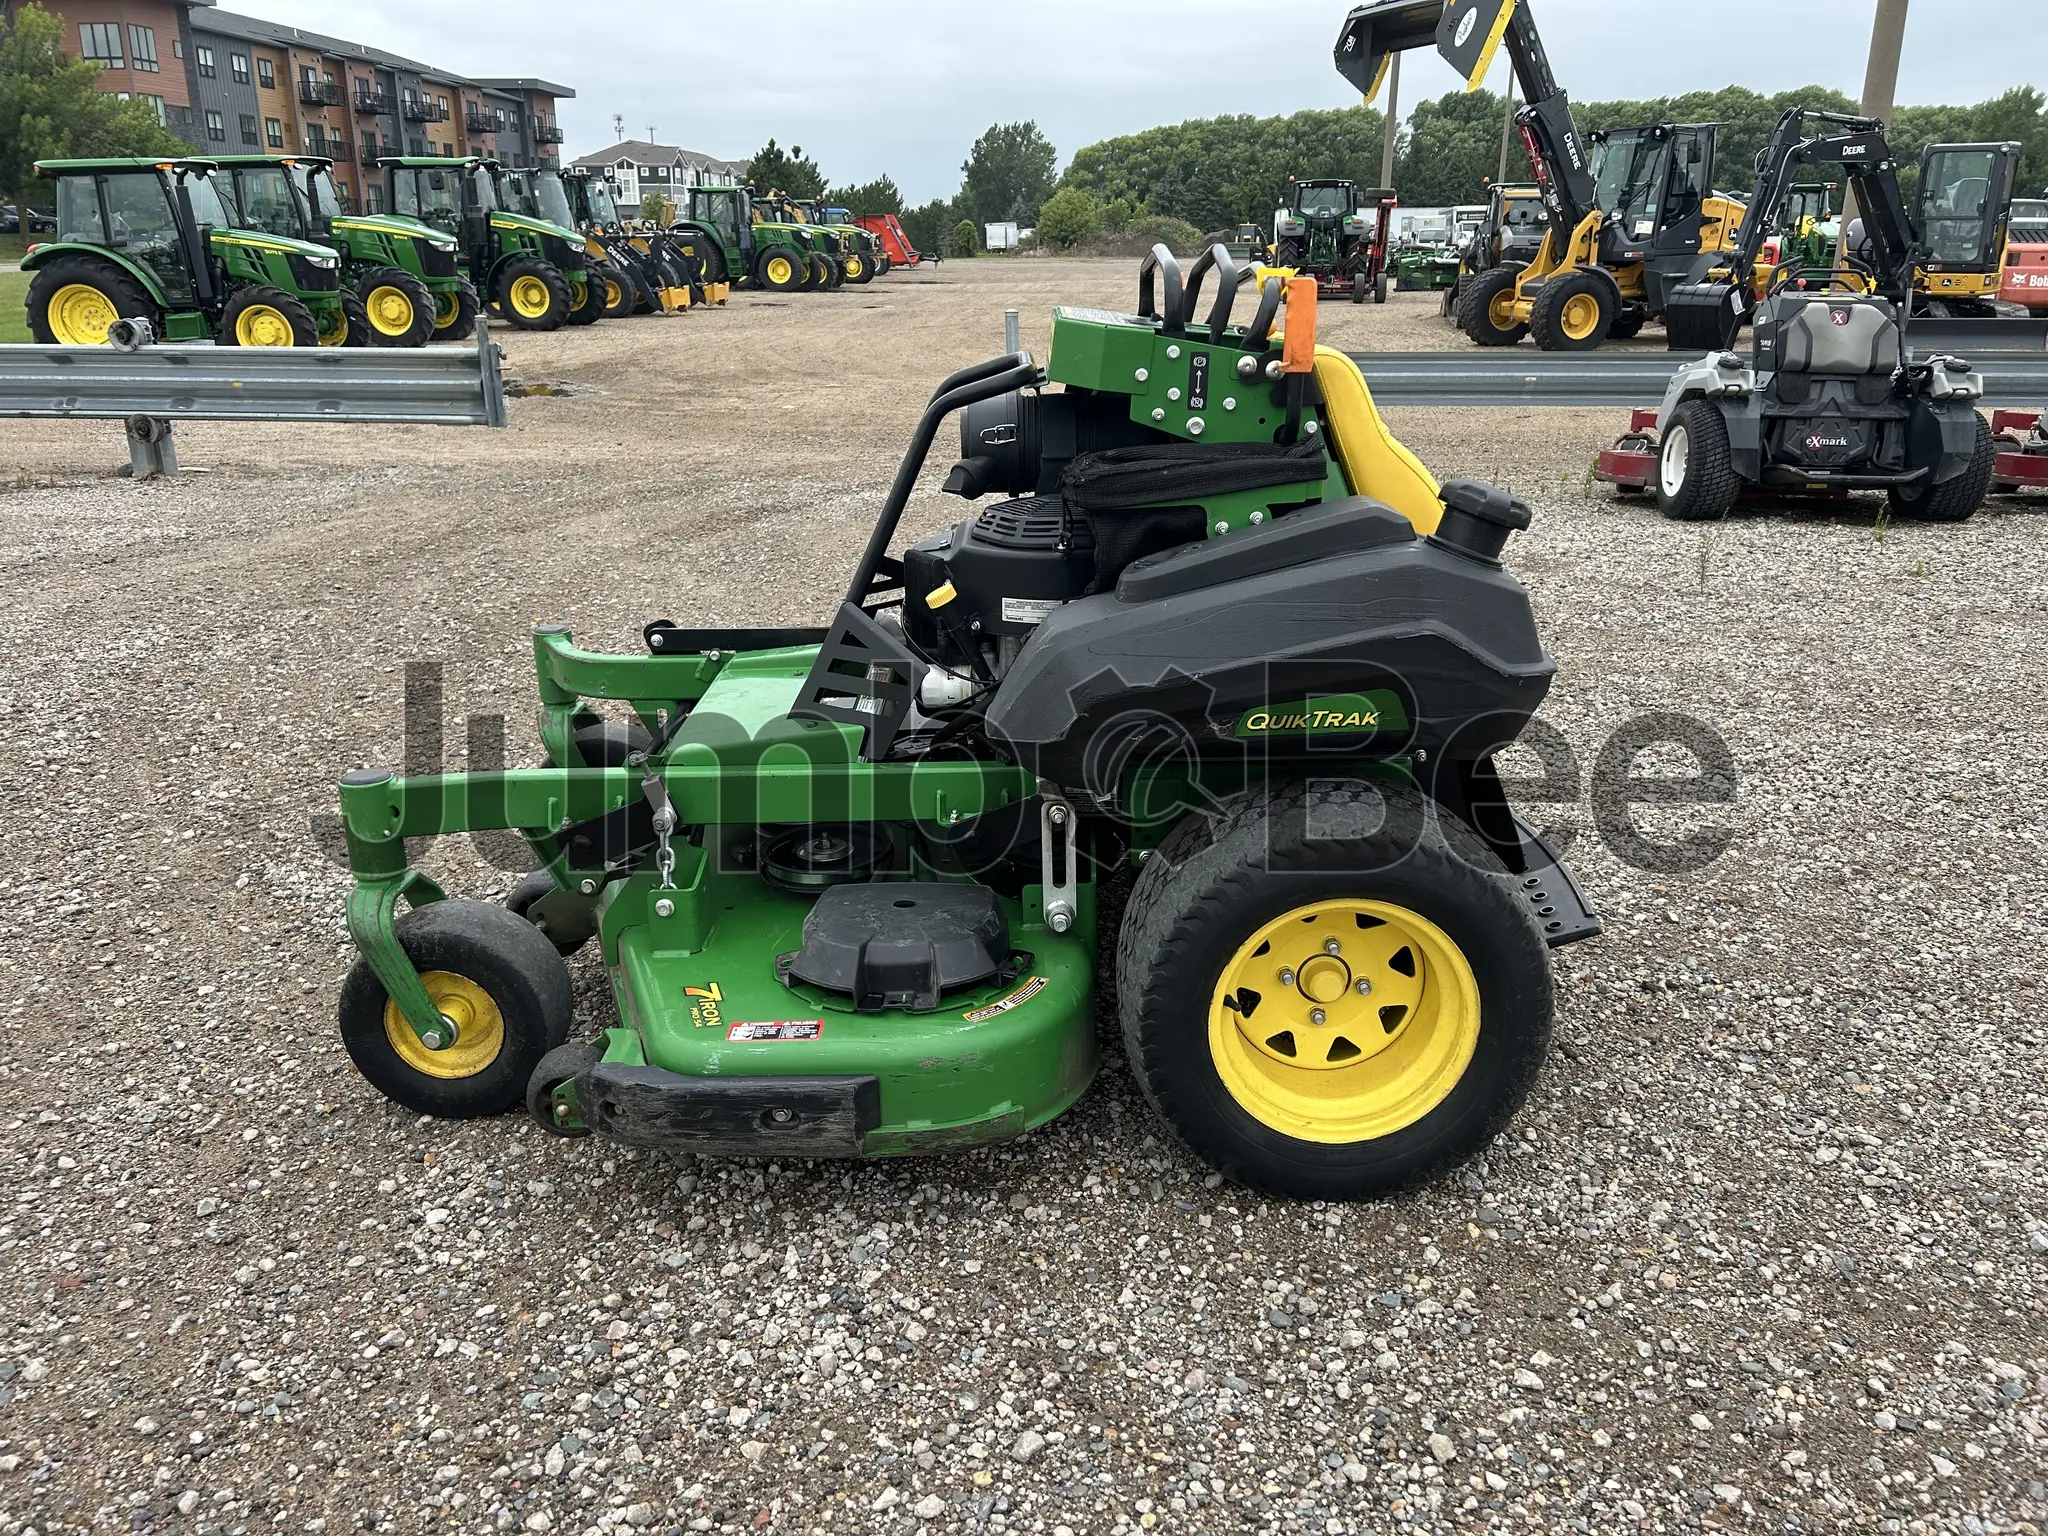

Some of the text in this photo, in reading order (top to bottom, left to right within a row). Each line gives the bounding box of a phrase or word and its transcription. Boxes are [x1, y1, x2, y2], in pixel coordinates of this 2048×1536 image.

[1623, 137, 1645, 145] DEERE
[1563, 131, 1582, 170] DEERE
[1842, 145, 1866, 156] DEERE
[607, 245, 630, 267] DEERE
